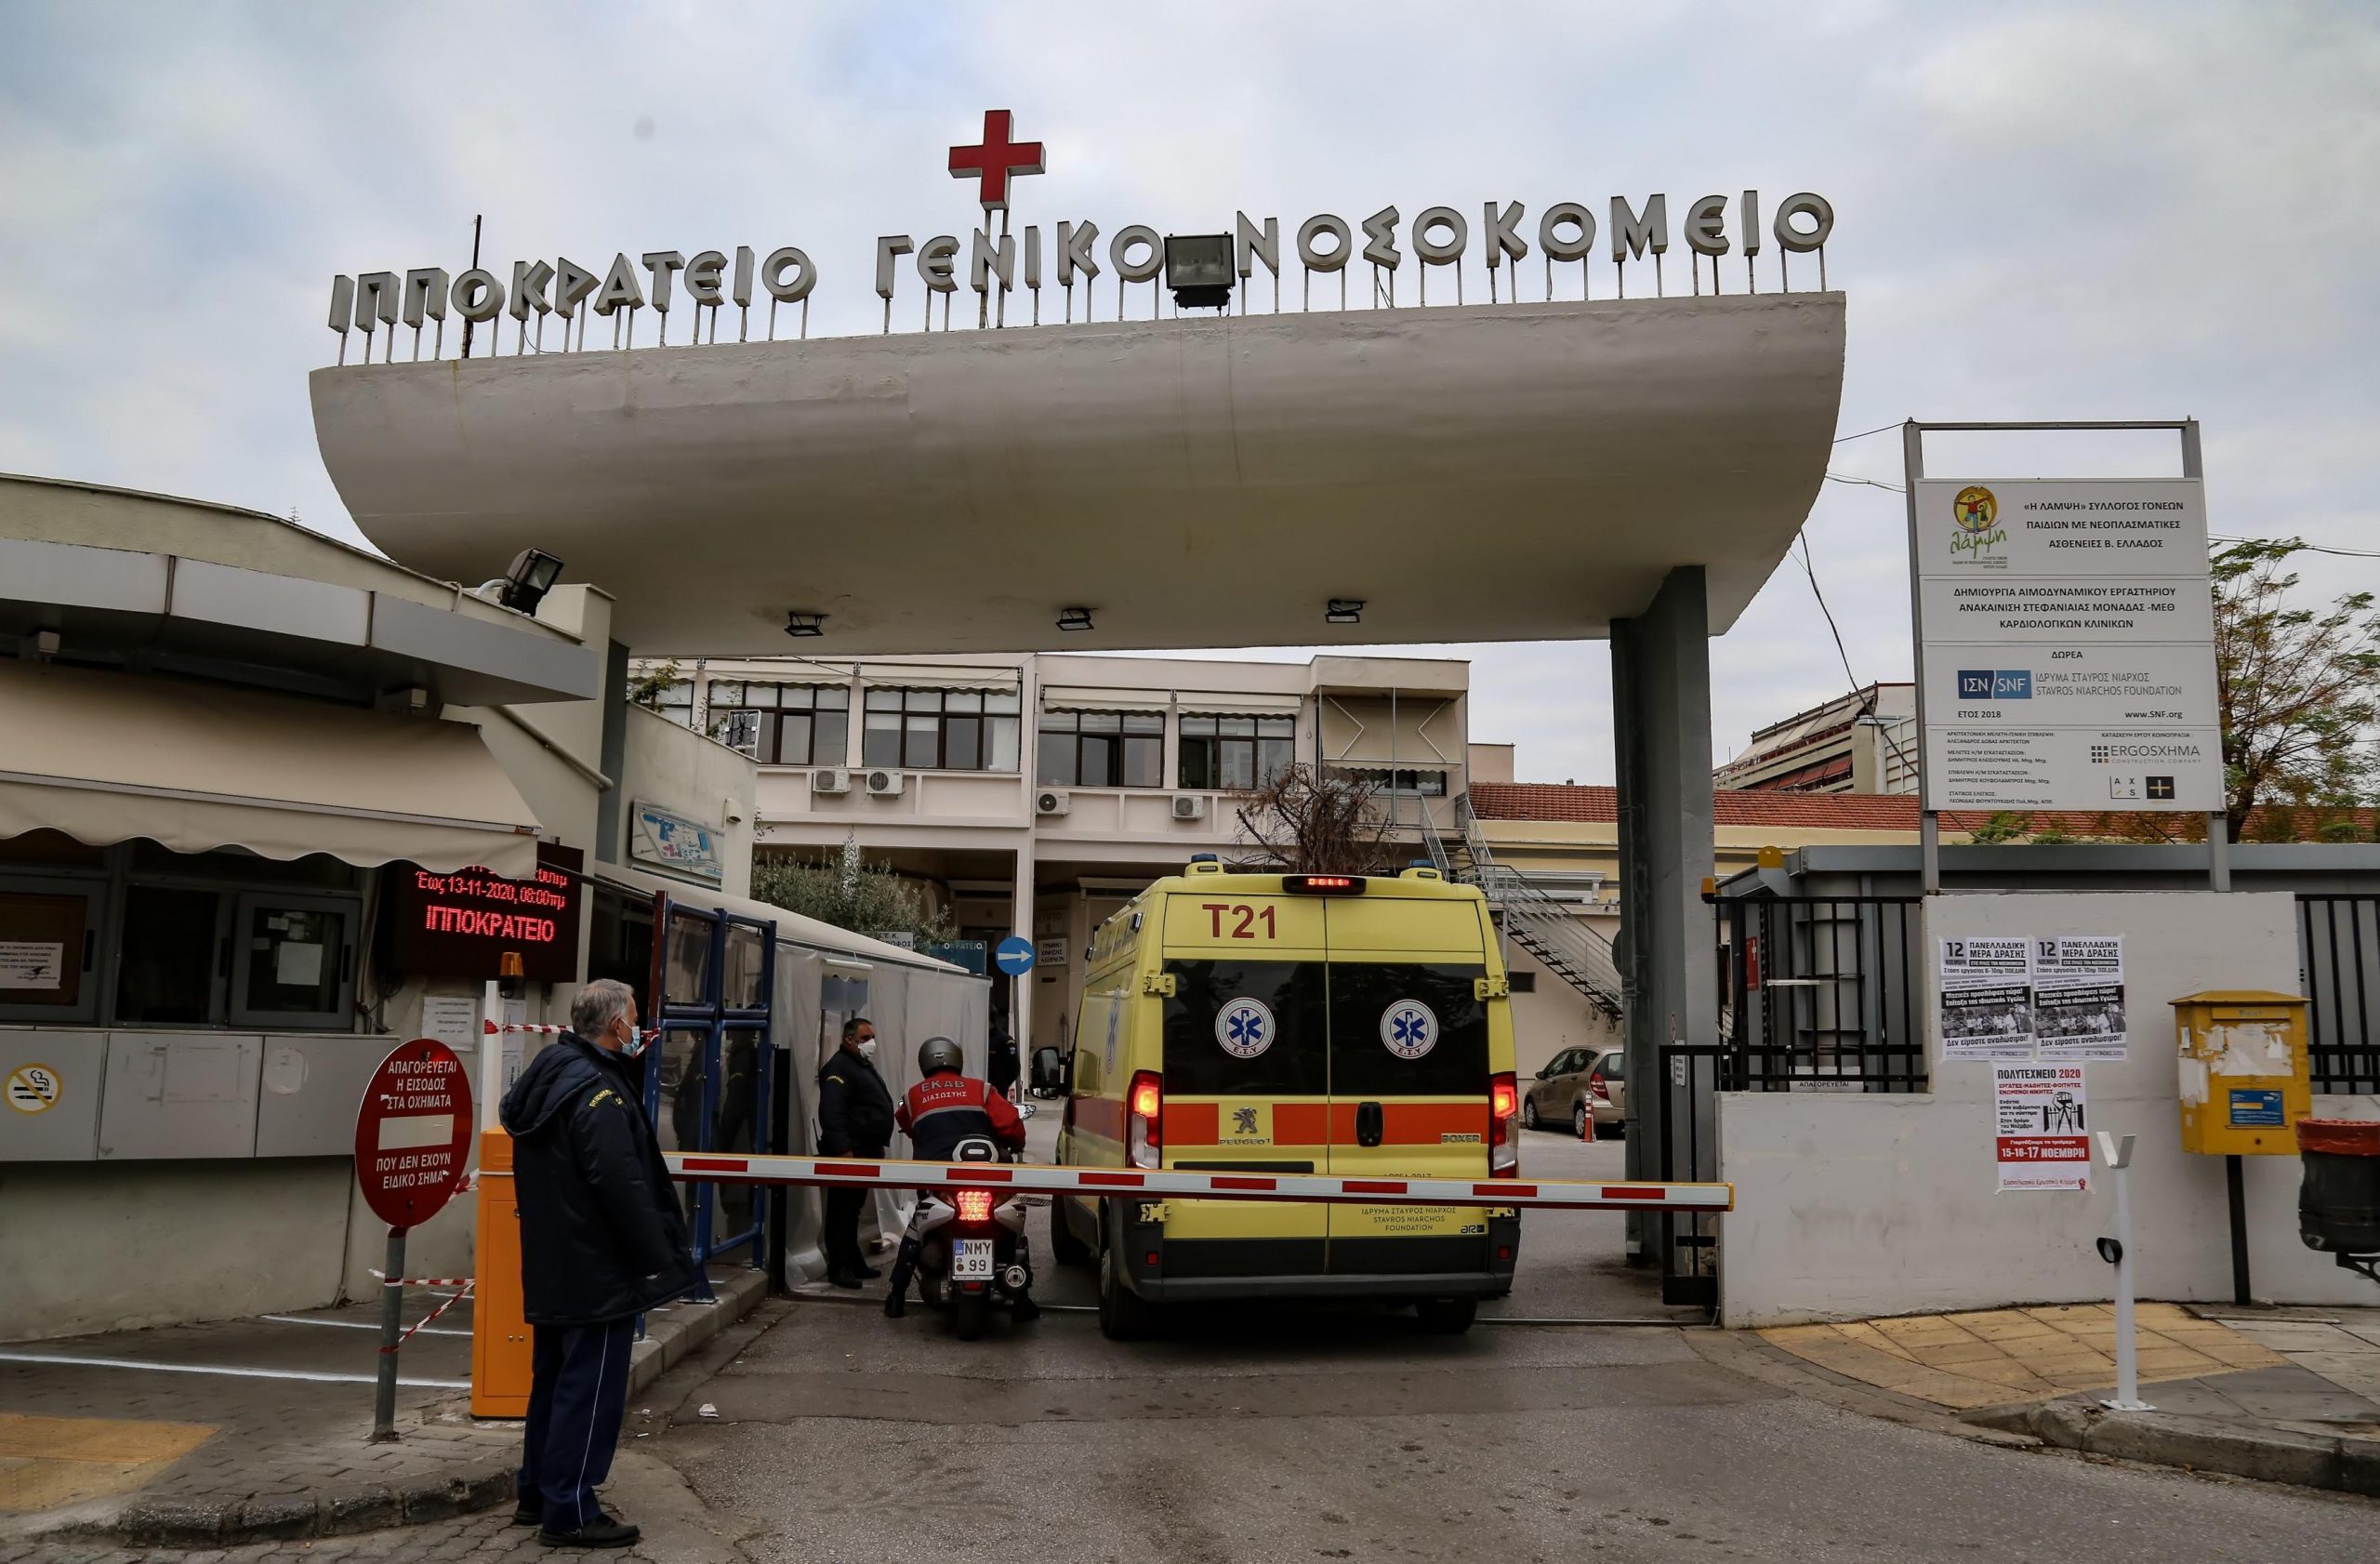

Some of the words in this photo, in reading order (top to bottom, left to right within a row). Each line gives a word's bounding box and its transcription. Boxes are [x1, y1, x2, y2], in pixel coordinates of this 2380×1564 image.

[328, 245, 817, 335] ΙΠΠΟΚΡΑΤΕΙΟ
[876, 219, 1164, 301] ΓΕΝΙΚΟ
[1236, 190, 1834, 279] ΝΟΣΟΚΟΜΕΙΟ
[2024, 502, 2037, 510] «Η
[2040, 502, 2086, 510] ΛΑΜΨΗ»
[2089, 502, 2140, 510] ΣΥΛΛΟΓΟΣ
[2142, 502, 2184, 510] ΓΟΝΕΩΝ
[2027, 521, 2069, 529] ΠΑΙΔΙΩΝ
[2071, 521, 2087, 529] ΜΕ
[2090, 521, 2181, 529] ΝΕΟΠΛΑΣΜΑΤΙΚΕΣ
[2049, 539, 2102, 548] ΑΣΘΕΝΕΙΕΣ
[2105, 539, 2114, 548] Β.
[2117, 539, 2163, 548] ΕΛΛΑΔΟΣ
[1953, 588, 2016, 596] ΔΗΜΙΟΥΡΓΙΑ
[2018, 588, 2108, 596] ΑΙΜΟΔΥΝΑΜΙΚΟΥ
[2110, 588, 2176, 596] ΕΡΓΑΣΤΗΡΙΟΥ
[1959, 603, 2020, 612] ΑΝΑΚΑΙΝΙΣΗ
[2023, 603, 2090, 612] ΣΤΕΦΑΝΙΑΙΑΣ
[2093, 603, 2145, 612] ΜΟΝΑΔΑΣ
[2147, 603, 2175, 612] -ΜΕΘ
[2000, 619, 2082, 629] ΚΑΡΔΙΟΛΟΓΙΚΩΝ
[2084, 619, 2134, 629] ΚΛΙΝΙΚΩΝ
[2051, 651, 2083, 659] ΔΩΡΕΑ
[2035, 672, 2069, 683] ΙΔΡΥΜΑ
[2071, 672, 2109, 683] ΣΤΑΥΡΟΣ
[2111, 672, 2149, 683] ΝΙΑΡΧΟΣ
[1964, 678, 1989, 692] ΙΣΝ
[1997, 678, 2027, 692] SNF
[2036, 686, 2073, 696] STAVROS
[2076, 686, 2122, 696] NIARCHOS
[2124, 686, 2182, 696] FOUNDATION
[1958, 710, 1979, 719] ΕΤΟΣ
[1981, 710, 2002, 719] 2018
[2124, 710, 2183, 720] www.SNF.org
[2110, 745, 2201, 757] ERGOSXHMA
[415, 870, 446, 895] Έως
[448, 876, 518, 905] 13-11-2020,
[519, 886, 566, 910] 08:00πμ
[425, 905, 556, 942] ΙΠΠΟΚΡΑΤΕΙΟ
[1202, 904, 1276, 940] T21
[1947, 942, 1964, 957] 12
[1970, 949, 1992, 958] ΜΕΡΑ
[1995, 949, 2026, 958] ΔΡΑΣΗΣ
[2039, 941, 2056, 957] 12
[2063, 948, 2084, 958] ΜΕΡΑ
[2087, 948, 2119, 958] ΔΡΑΣΗΣ
[1961, 1038, 1986, 1046] είμαστε
[1988, 1034, 2029, 1044] αναλώσιμοι!
[2055, 1038, 2080, 1046] είμαστε
[2082, 1034, 2122, 1044] αναλώσιμοι!
[388, 1061, 457, 1074] ΑΠΑΓΟΡΕΥΕΤΑΙ
[1998, 1069, 2056, 1080] ΠΟΛΥΤΕΧΝΕΙΟ
[2059, 1068, 2082, 1079] 2020
[397, 1079, 404, 1092] Η
[406, 1078, 446, 1092] ΕΙΣΟΔΟΣ
[921, 1080, 965, 1093] ΕΚΑΒ
[387, 1096, 405, 1110] ΣΤΑ
[408, 1094, 452, 1109] ΟΧΗΜΑΤΑ
[922, 1091, 968, 1104] ΔΙΑΣΩΣΤΗΣ
[1442, 1134, 1481, 1143] BOXER
[2002, 1146, 2039, 1159] 15-16-17
[2041, 1147, 2085, 1158] ΝΟΕΜΒΡΗ
[377, 1157, 398, 1173] ΠΟΥ
[399, 1155, 419, 1170] ΔΕΝ
[421, 1152, 452, 1167] ΕΧΟΥΝ
[383, 1173, 416, 1189] ΕΙΔΙΚΟ
[418, 1170, 443, 1186] ΣΗΜΑ
[965, 1242, 991, 1255] NMY
[969, 1259, 987, 1272] 99
